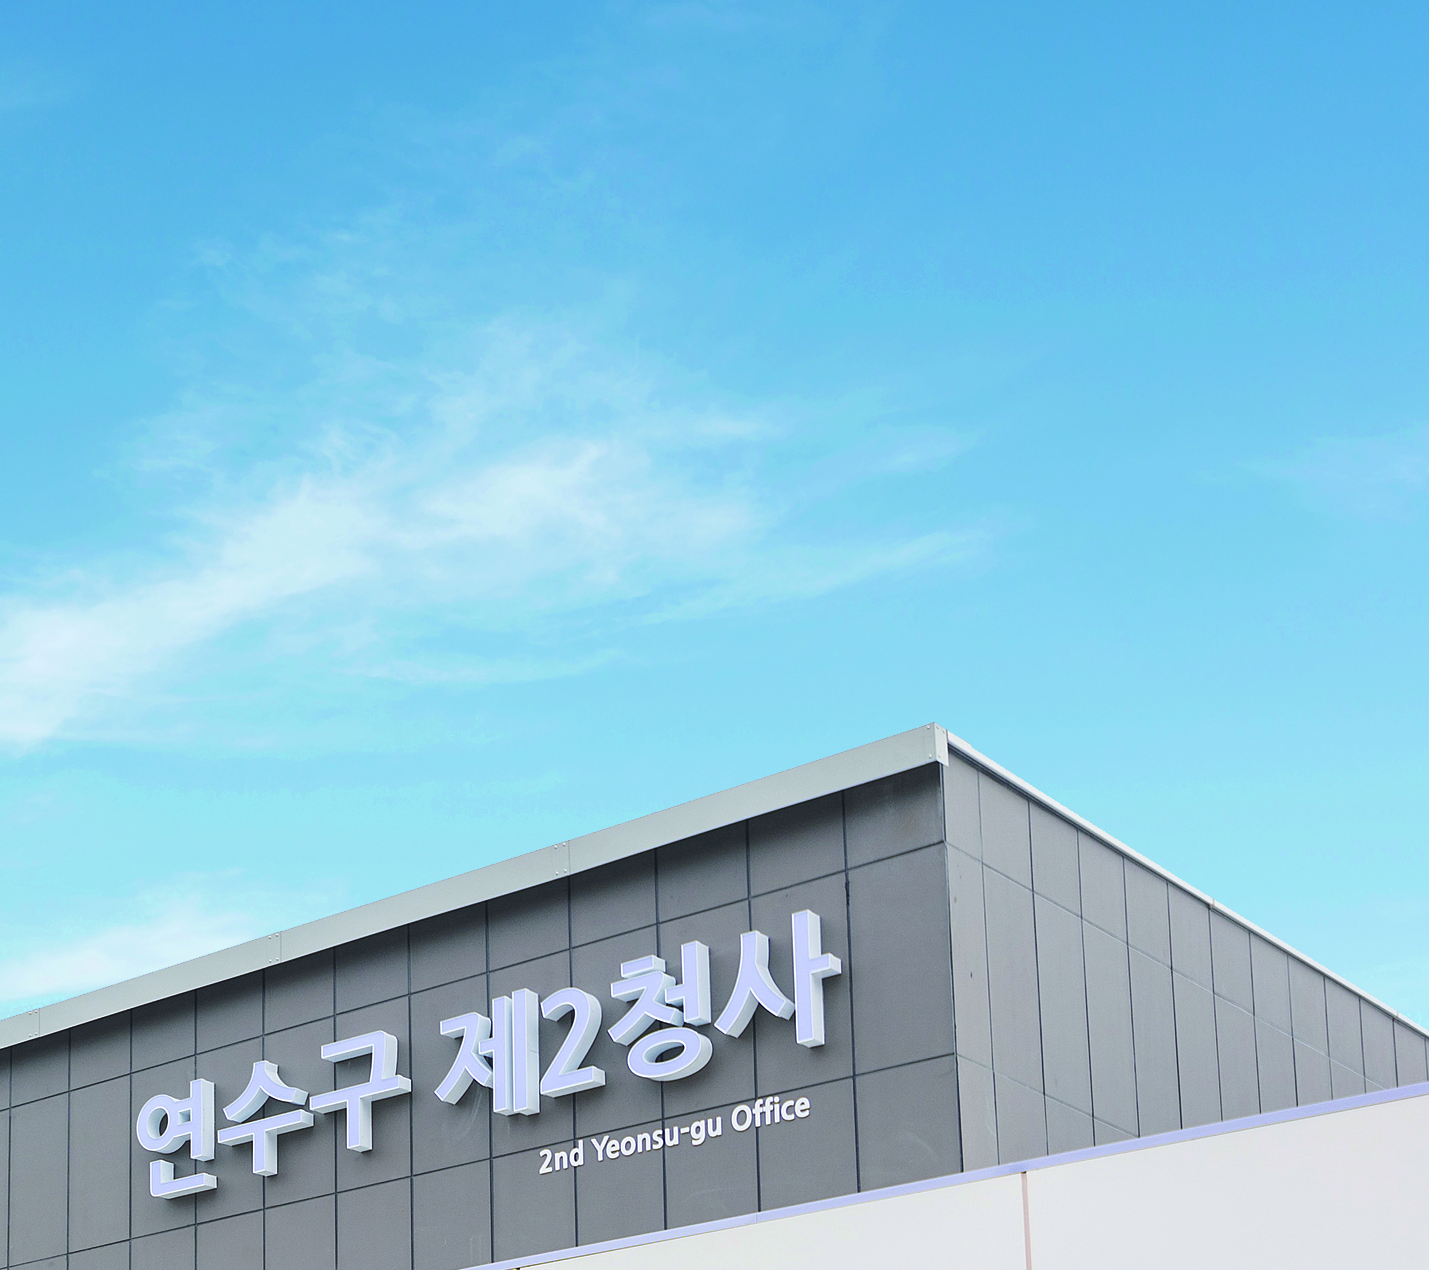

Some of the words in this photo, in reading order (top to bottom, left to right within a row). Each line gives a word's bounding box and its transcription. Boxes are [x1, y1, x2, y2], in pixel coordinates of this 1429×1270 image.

[136, 1030, 411, 1201] 연수구
[433, 908, 841, 1118] 제2청사
[538, 1140, 584, 1174] 2nd
[590, 1116, 722, 1162] Yeonsu-gu
[731, 1097, 810, 1132] Office
